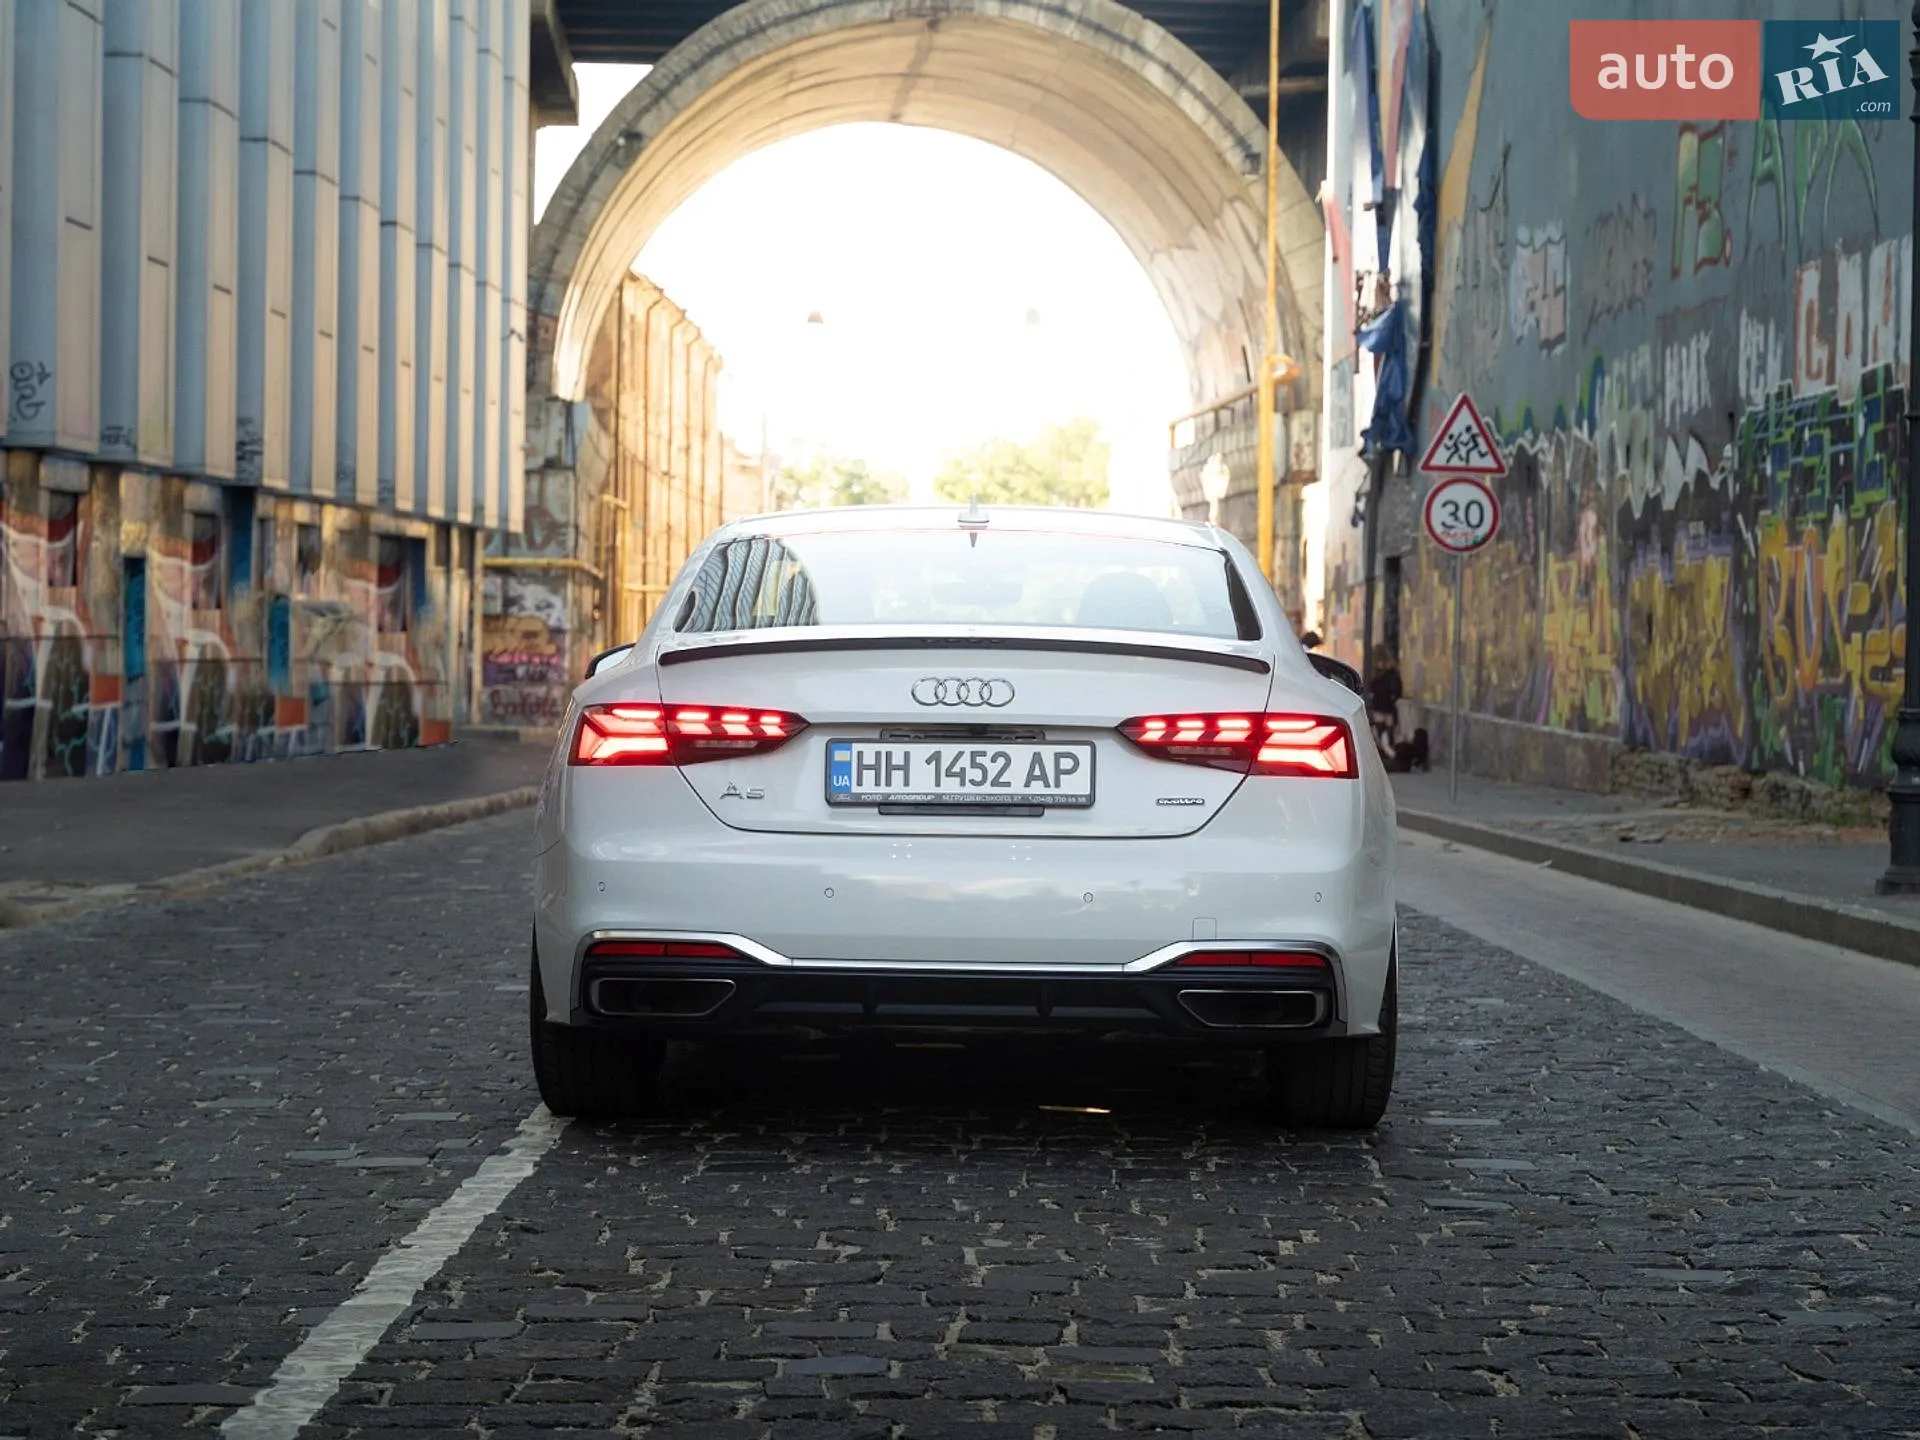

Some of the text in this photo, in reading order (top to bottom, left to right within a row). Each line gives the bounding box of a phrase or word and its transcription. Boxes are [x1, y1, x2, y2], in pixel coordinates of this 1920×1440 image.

[1440, 500, 1485, 529] 30
[833, 775, 851, 787] UA
[856, 750, 1080, 788] HH 1452 AP
